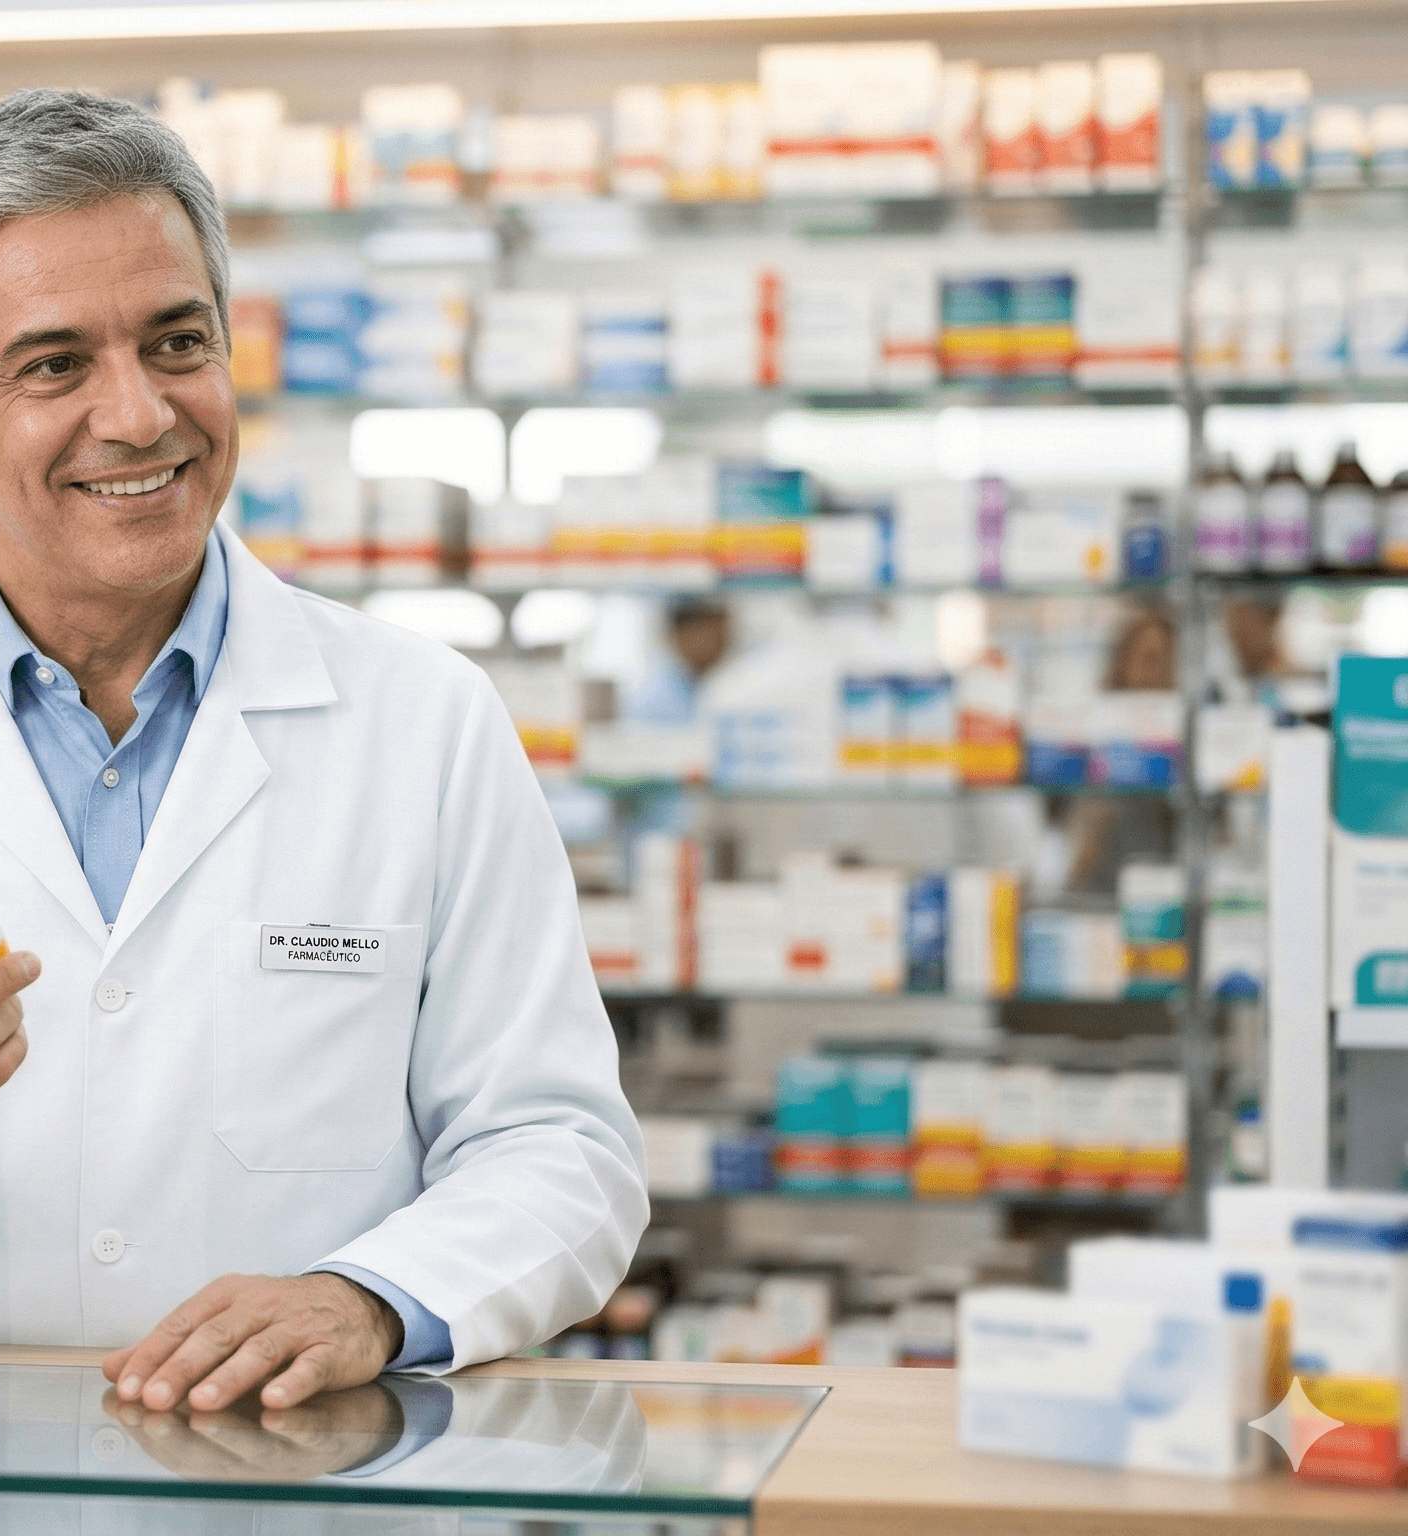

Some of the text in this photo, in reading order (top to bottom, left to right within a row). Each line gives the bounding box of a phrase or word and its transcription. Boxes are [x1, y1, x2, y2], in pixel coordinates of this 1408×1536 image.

[269, 936, 380, 949] DR. CLAUDIO MELLO
[288, 949, 361, 962] FARMACÊUTICO
